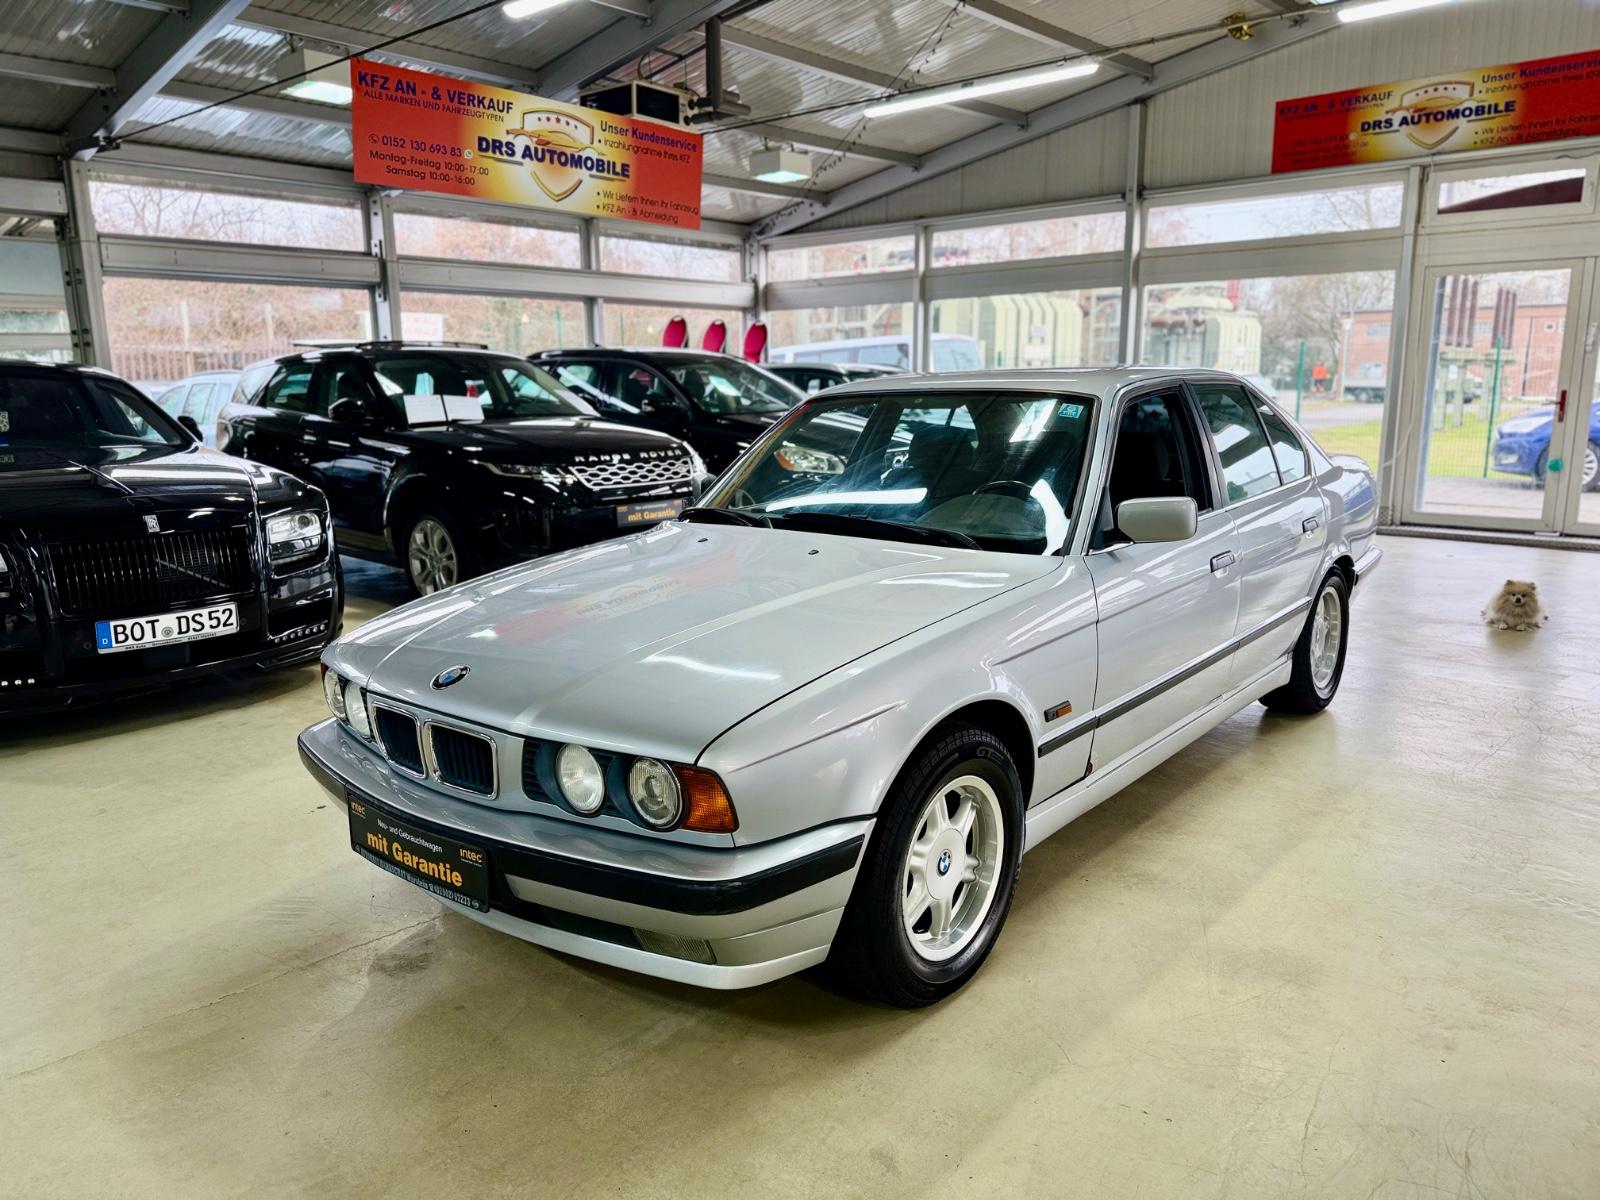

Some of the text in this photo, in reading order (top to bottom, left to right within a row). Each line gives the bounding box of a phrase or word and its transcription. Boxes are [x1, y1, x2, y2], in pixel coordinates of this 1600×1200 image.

[1481, 71, 1516, 84] Unser
[357, 71, 390, 91] KFZ
[395, 79, 416, 97] AN
[431, 86, 442, 101] &
[446, 89, 514, 114] VERKAUF
[1340, 90, 1394, 108] VERKAUF
[364, 89, 504, 122] ALLE MARKEN UND FAHRZEUGTYPEN
[1360, 118, 1394, 133] DRS
[1398, 100, 1517, 127] AUTOMOBILE
[382, 135, 462, 158] 0152 130 693 83
[600, 120, 698, 153] Unser Kundenservice
[369, 149, 441, 170] Montag-Freitag
[477, 136, 631, 179] DRS AUTOMOBILE
[386, 165, 426, 181] Samstag
[602, 189, 614, 200] Wir
[602, 203, 615, 214] KFZ
[639, 450, 682, 458] ROVER
[112, 618, 160, 645] BOT
[367, 831, 389, 855] mit
[392, 842, 463, 887] Garantie
